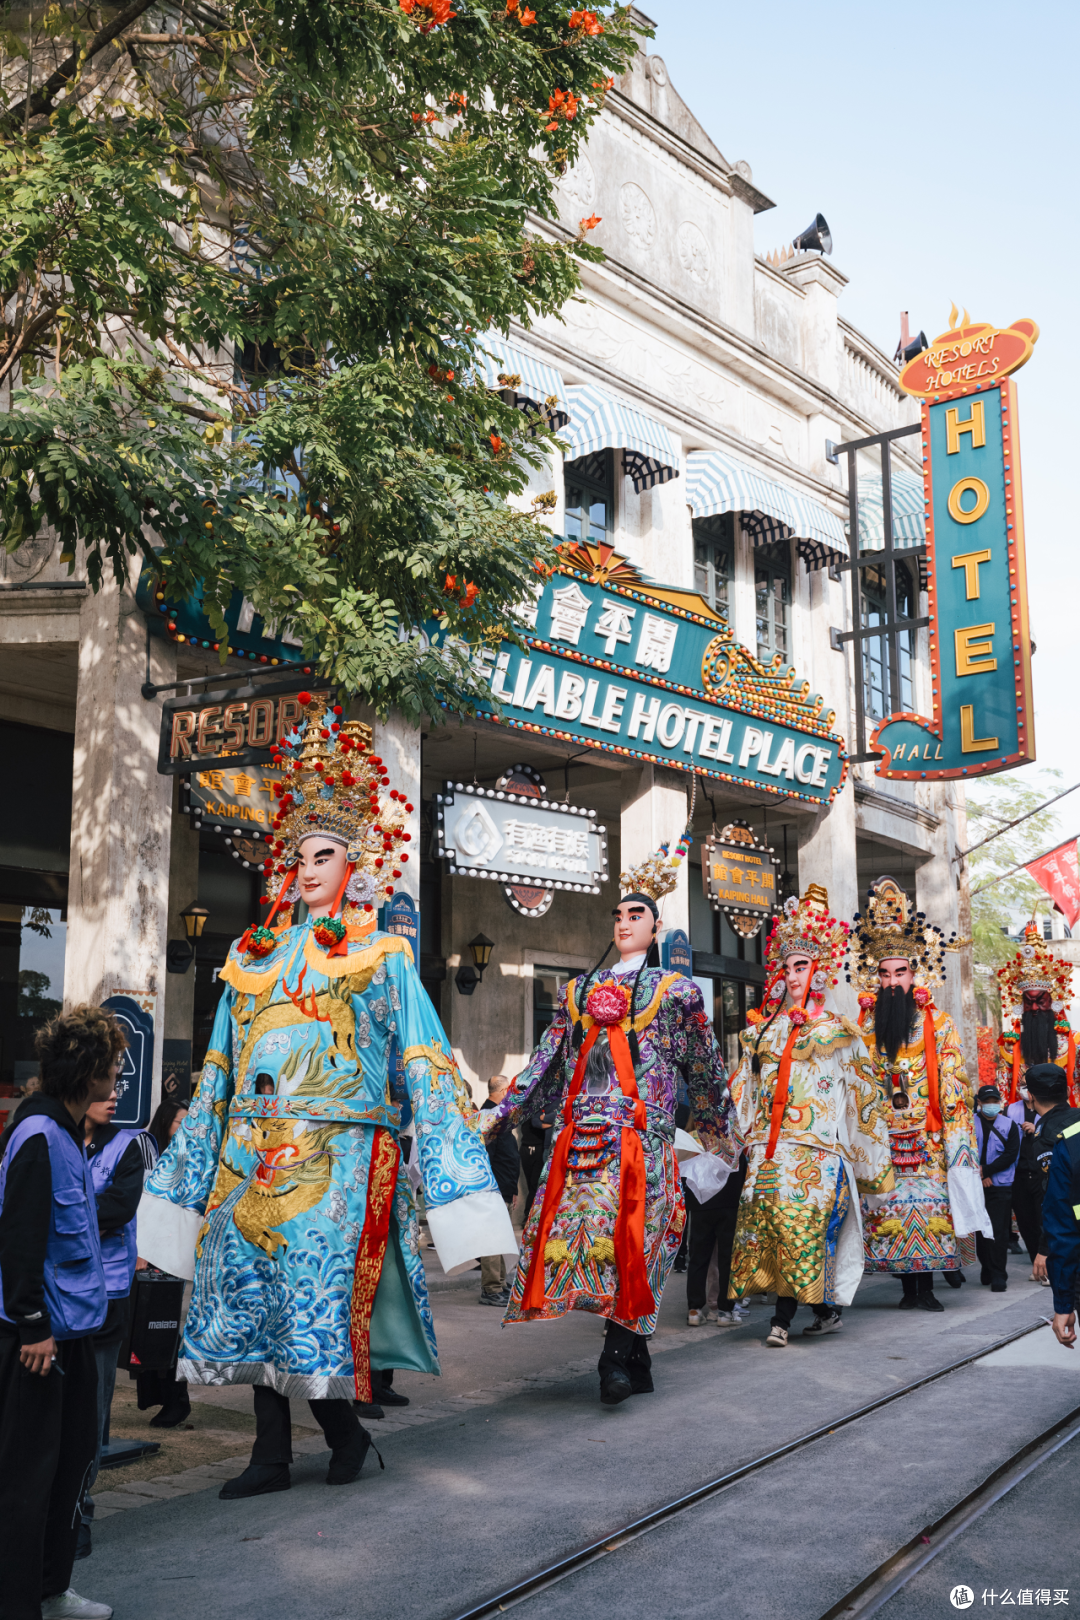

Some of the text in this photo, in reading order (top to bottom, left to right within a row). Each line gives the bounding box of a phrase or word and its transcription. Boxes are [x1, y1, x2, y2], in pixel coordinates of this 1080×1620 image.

[924, 331, 1000, 369] RESORT
[925, 357, 1000, 392] HOTELS
[944, 400, 999, 754] HOTEL
[169, 691, 332, 758] RESOR
[628, 692, 735, 765] HOTEL
[738, 725, 833, 789] PLACE
[892, 743, 944, 762] HALL
[206, 800, 265, 824] KAIPING
[722, 850, 763, 865] RESORT HOTEL
[718, 888, 770, 907] KAIPING HALL
[147, 1320, 178, 1329] malata
